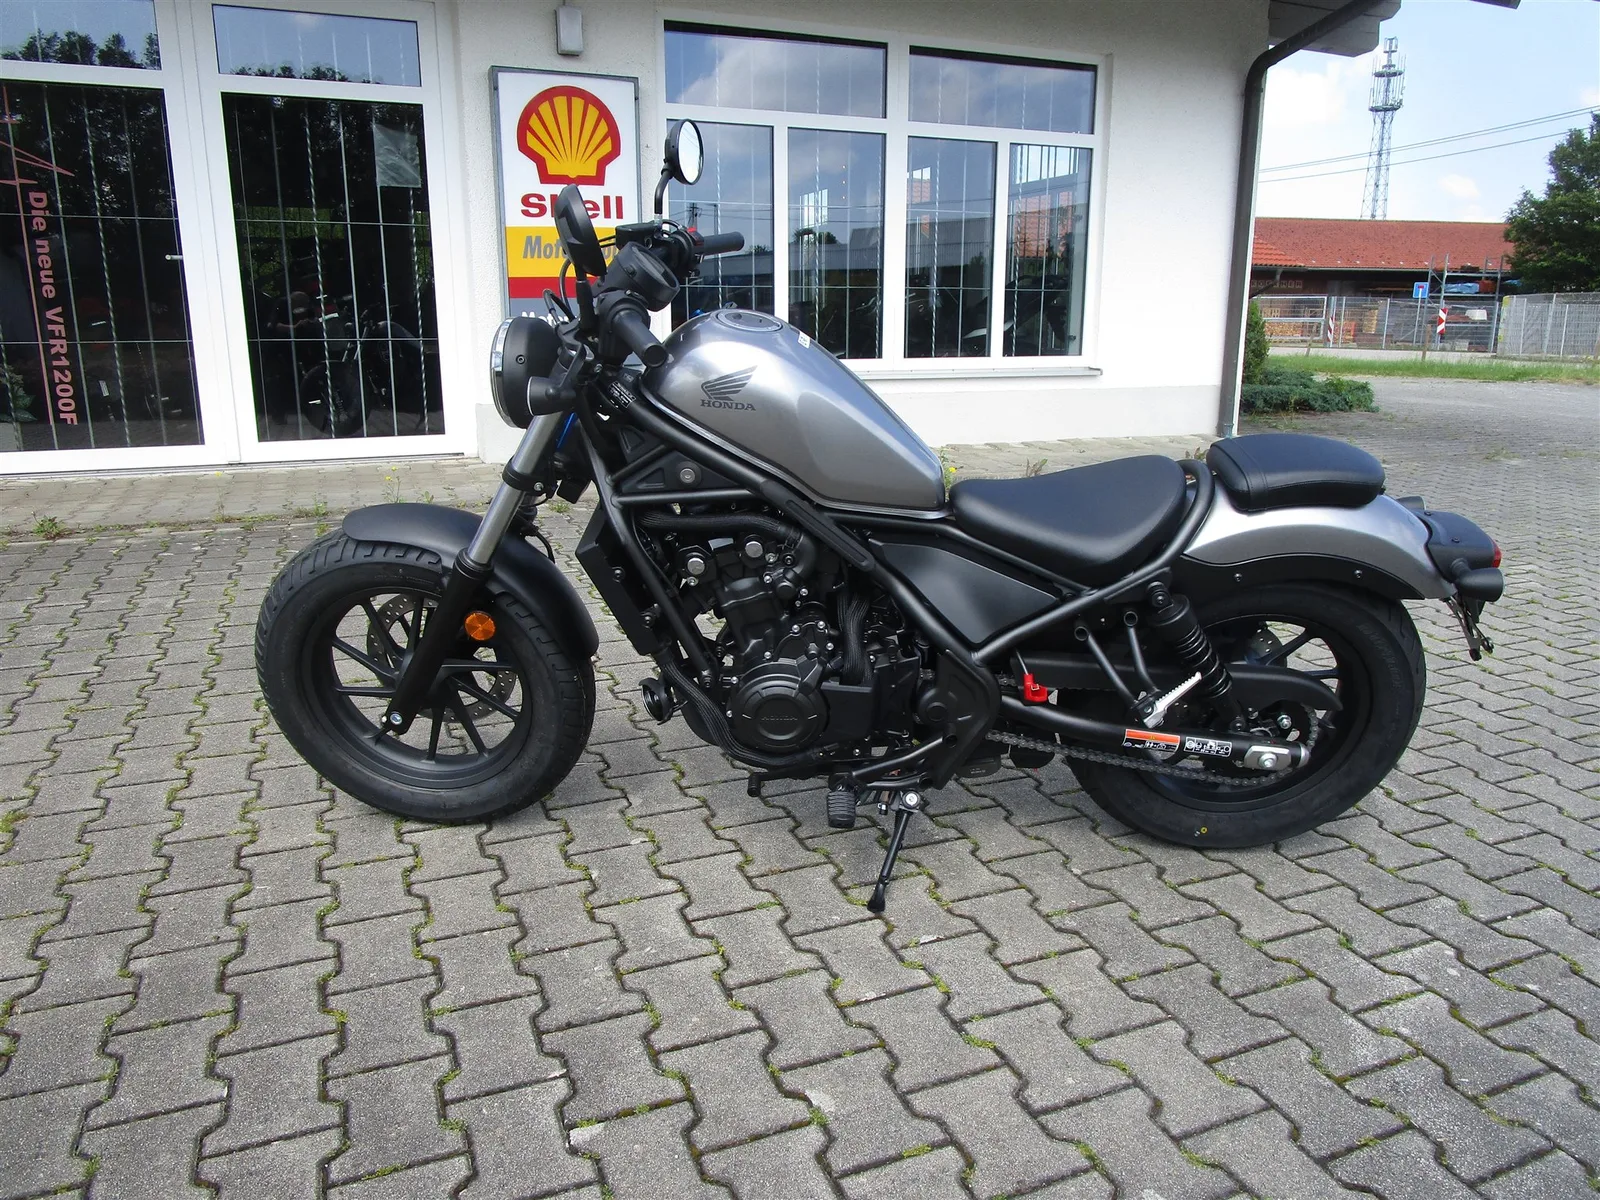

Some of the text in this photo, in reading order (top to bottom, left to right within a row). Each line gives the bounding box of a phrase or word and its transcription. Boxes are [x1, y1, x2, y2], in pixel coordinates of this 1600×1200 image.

[28, 191, 78, 425] Die neue VFR1200F
[700, 399, 756, 411] HONDA
